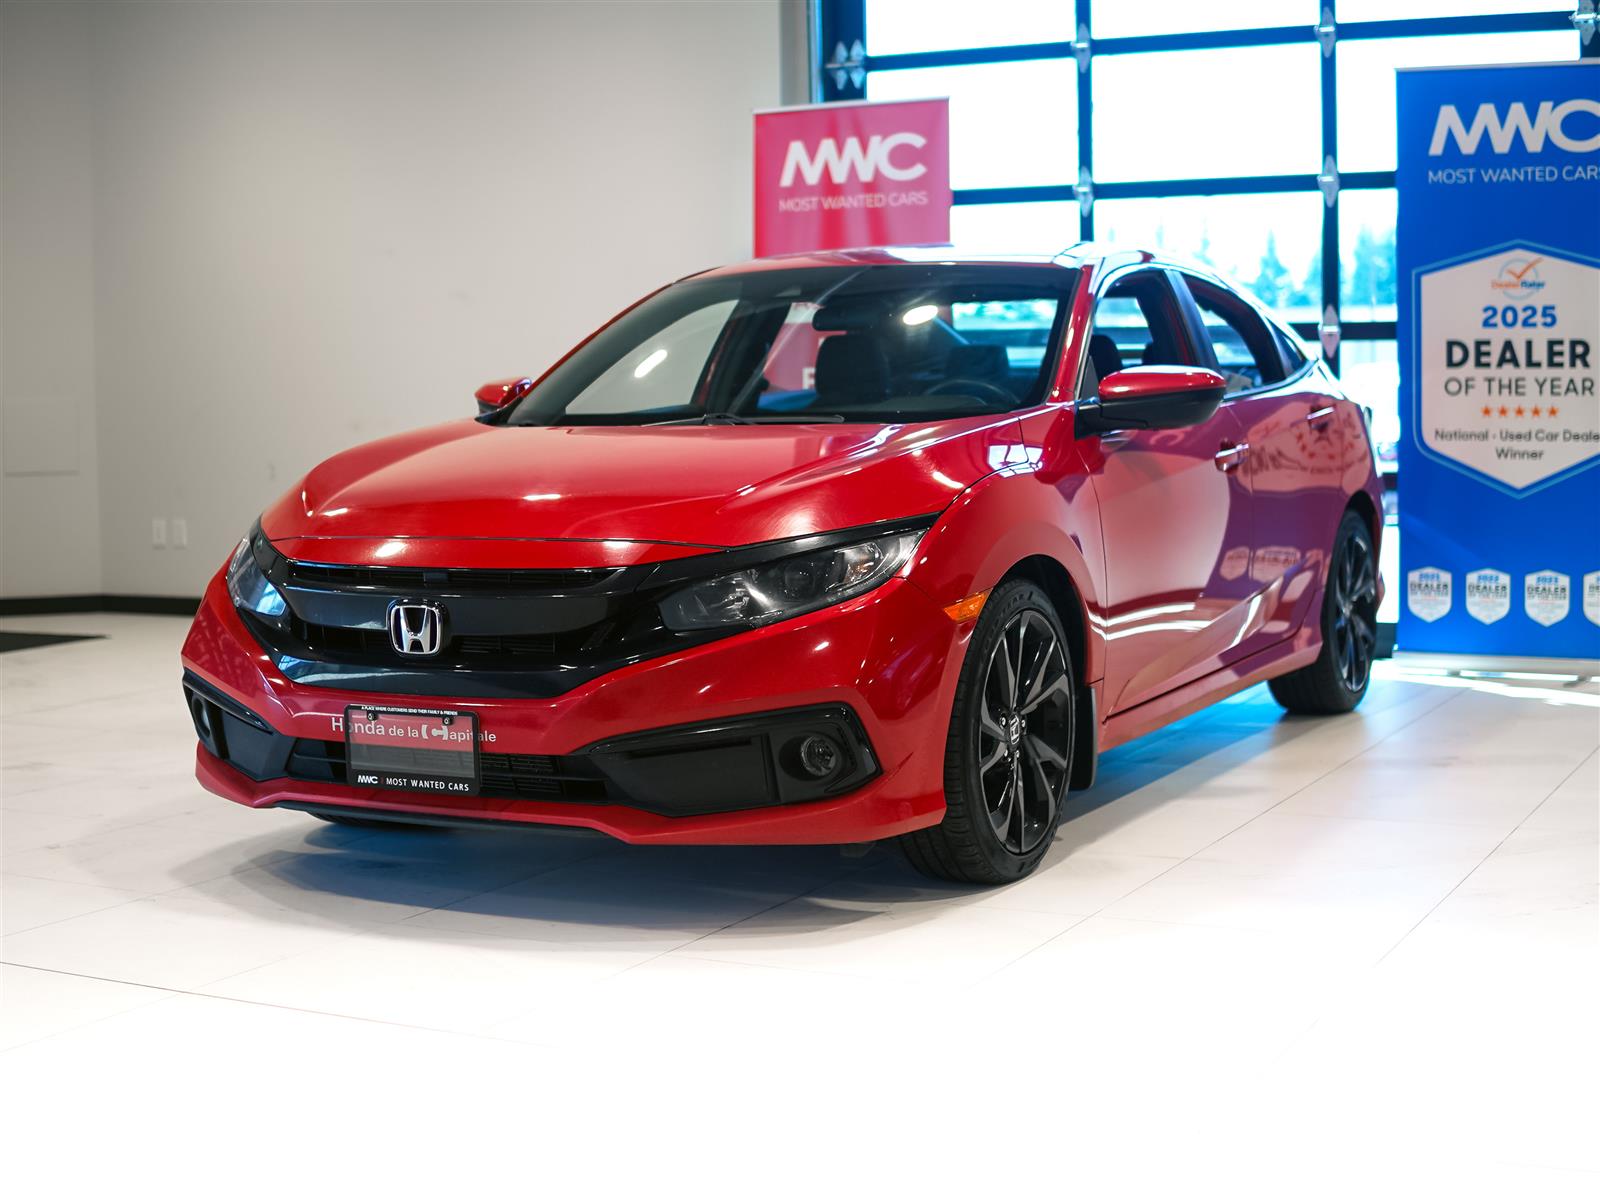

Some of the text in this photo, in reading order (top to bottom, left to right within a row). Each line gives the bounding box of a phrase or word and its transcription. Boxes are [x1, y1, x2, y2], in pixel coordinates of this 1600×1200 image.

[1428, 99, 1600, 156] MWC
[780, 132, 927, 188] MWC
[1428, 165, 1600, 184] MOST WANTED CAR
[779, 191, 928, 212] MOST WANTED CARS
[1482, 305, 1557, 329] 2025
[1446, 339, 1591, 369] DEALER
[1444, 376, 1595, 397] OF THE YEAR
[1434, 428, 1489, 442] National
[1500, 428, 1532, 442] Used
[1535, 429, 1559, 442] Car
[1562, 429, 1600, 442] Deale
[1495, 447, 1544, 460] Winner
[389, 725, 404, 737] de
[408, 726, 419, 738] la
[421, 724, 497, 743] Capiale
[357, 774, 470, 792] MWC MOST WANTED CARS
